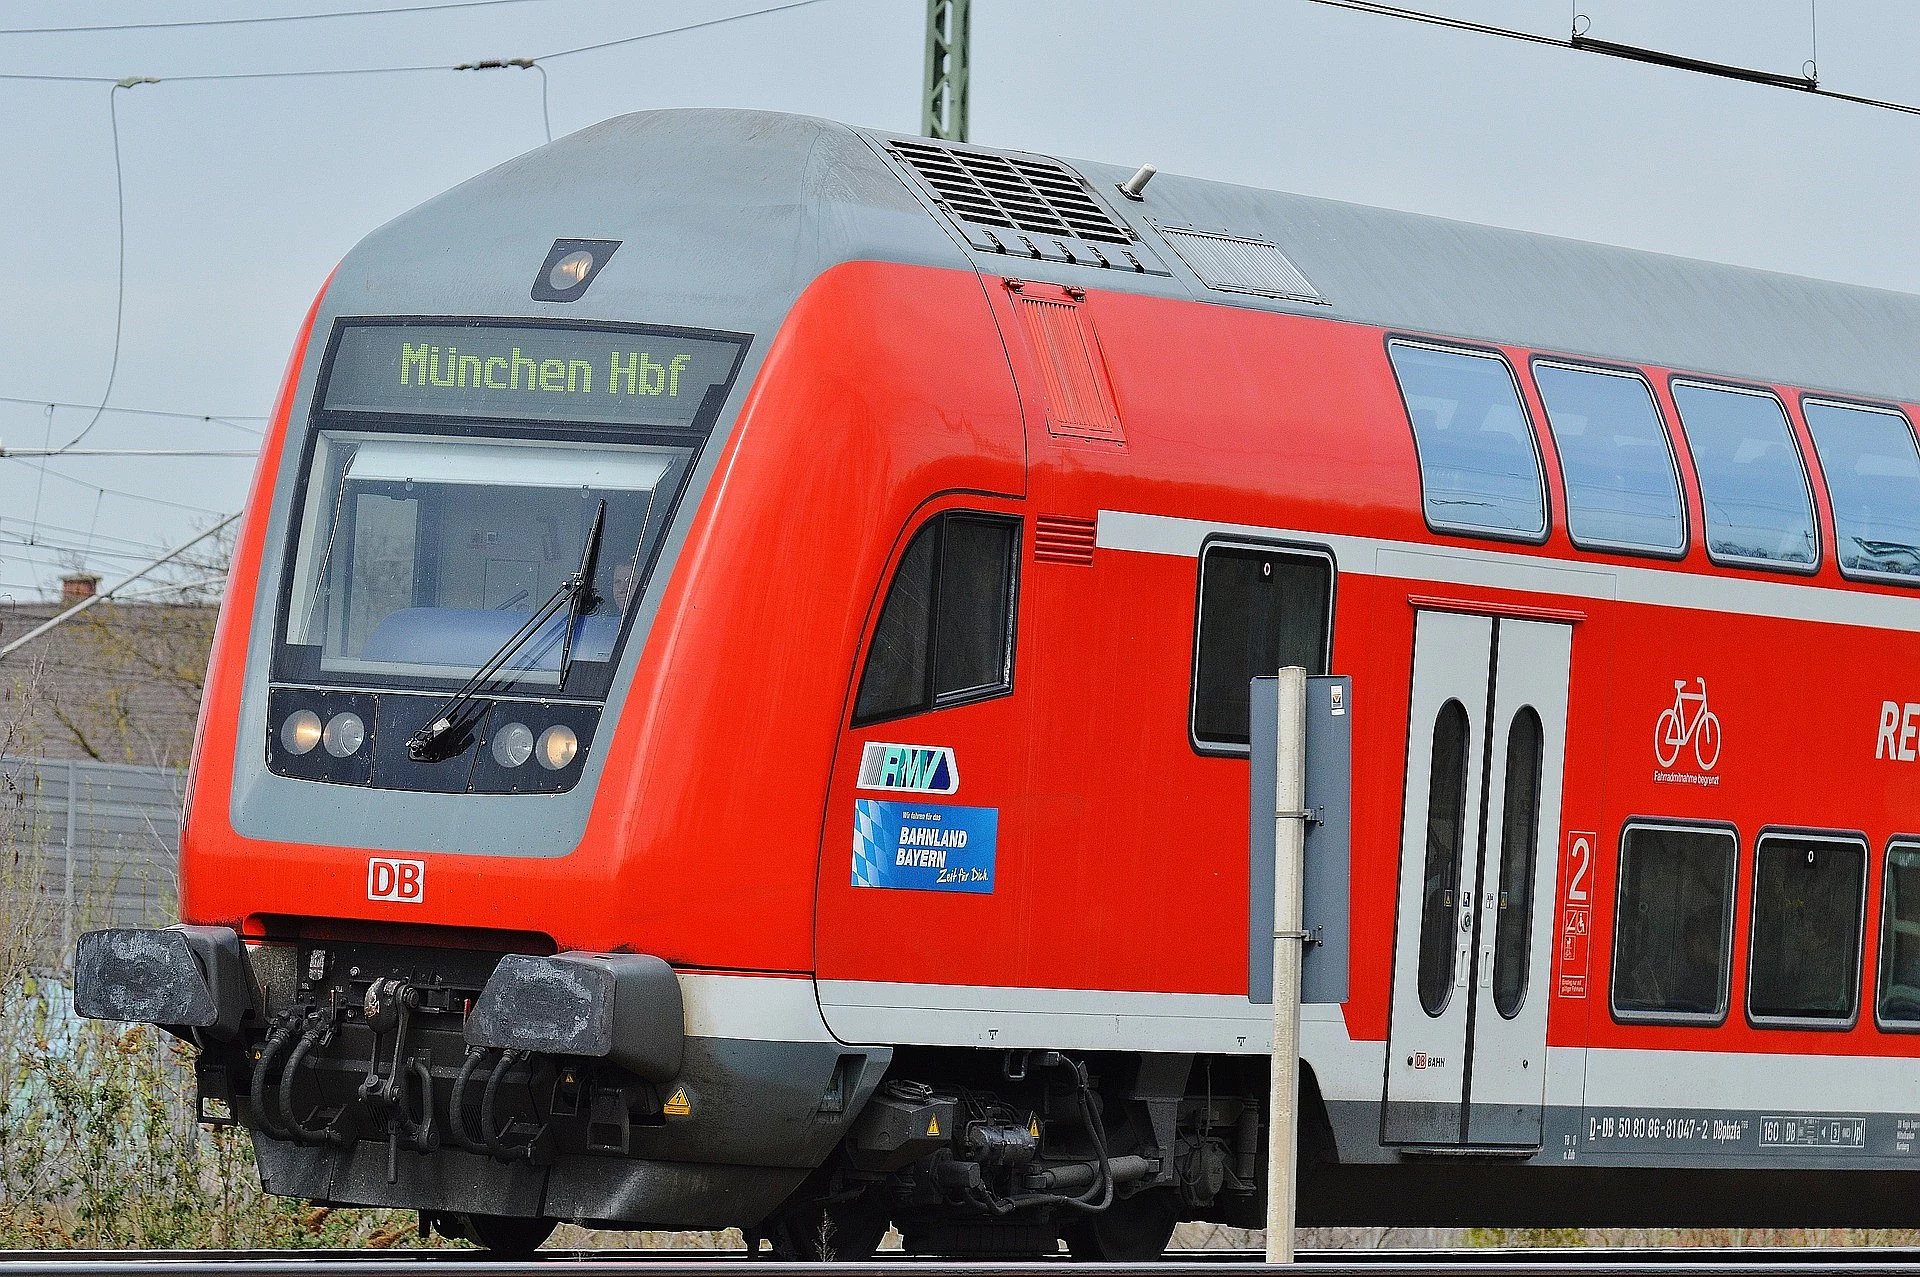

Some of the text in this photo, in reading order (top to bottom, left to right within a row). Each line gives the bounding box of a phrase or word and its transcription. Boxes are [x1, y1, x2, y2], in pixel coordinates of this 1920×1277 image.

[400, 342, 692, 397] München Hbf
[1875, 700, 1920, 762] RE
[880, 746, 944, 789] RMV
[899, 826, 968, 848] BAHNLAND
[895, 848, 947, 868] BAYERN
[1569, 837, 1590, 901] 2
[371, 861, 421, 899] DB
[936, 868, 957, 883] Zeit
[957, 867, 970, 883] für
[1416, 1054, 1445, 1068] DB BAHN
[1589, 1117, 1614, 1141] D-DB
[1618, 1117, 1630, 1138] 50
[1633, 1118, 1645, 1138] 80
[1764, 1121, 1779, 1142] 160
[1786, 1122, 1796, 1142] DB
